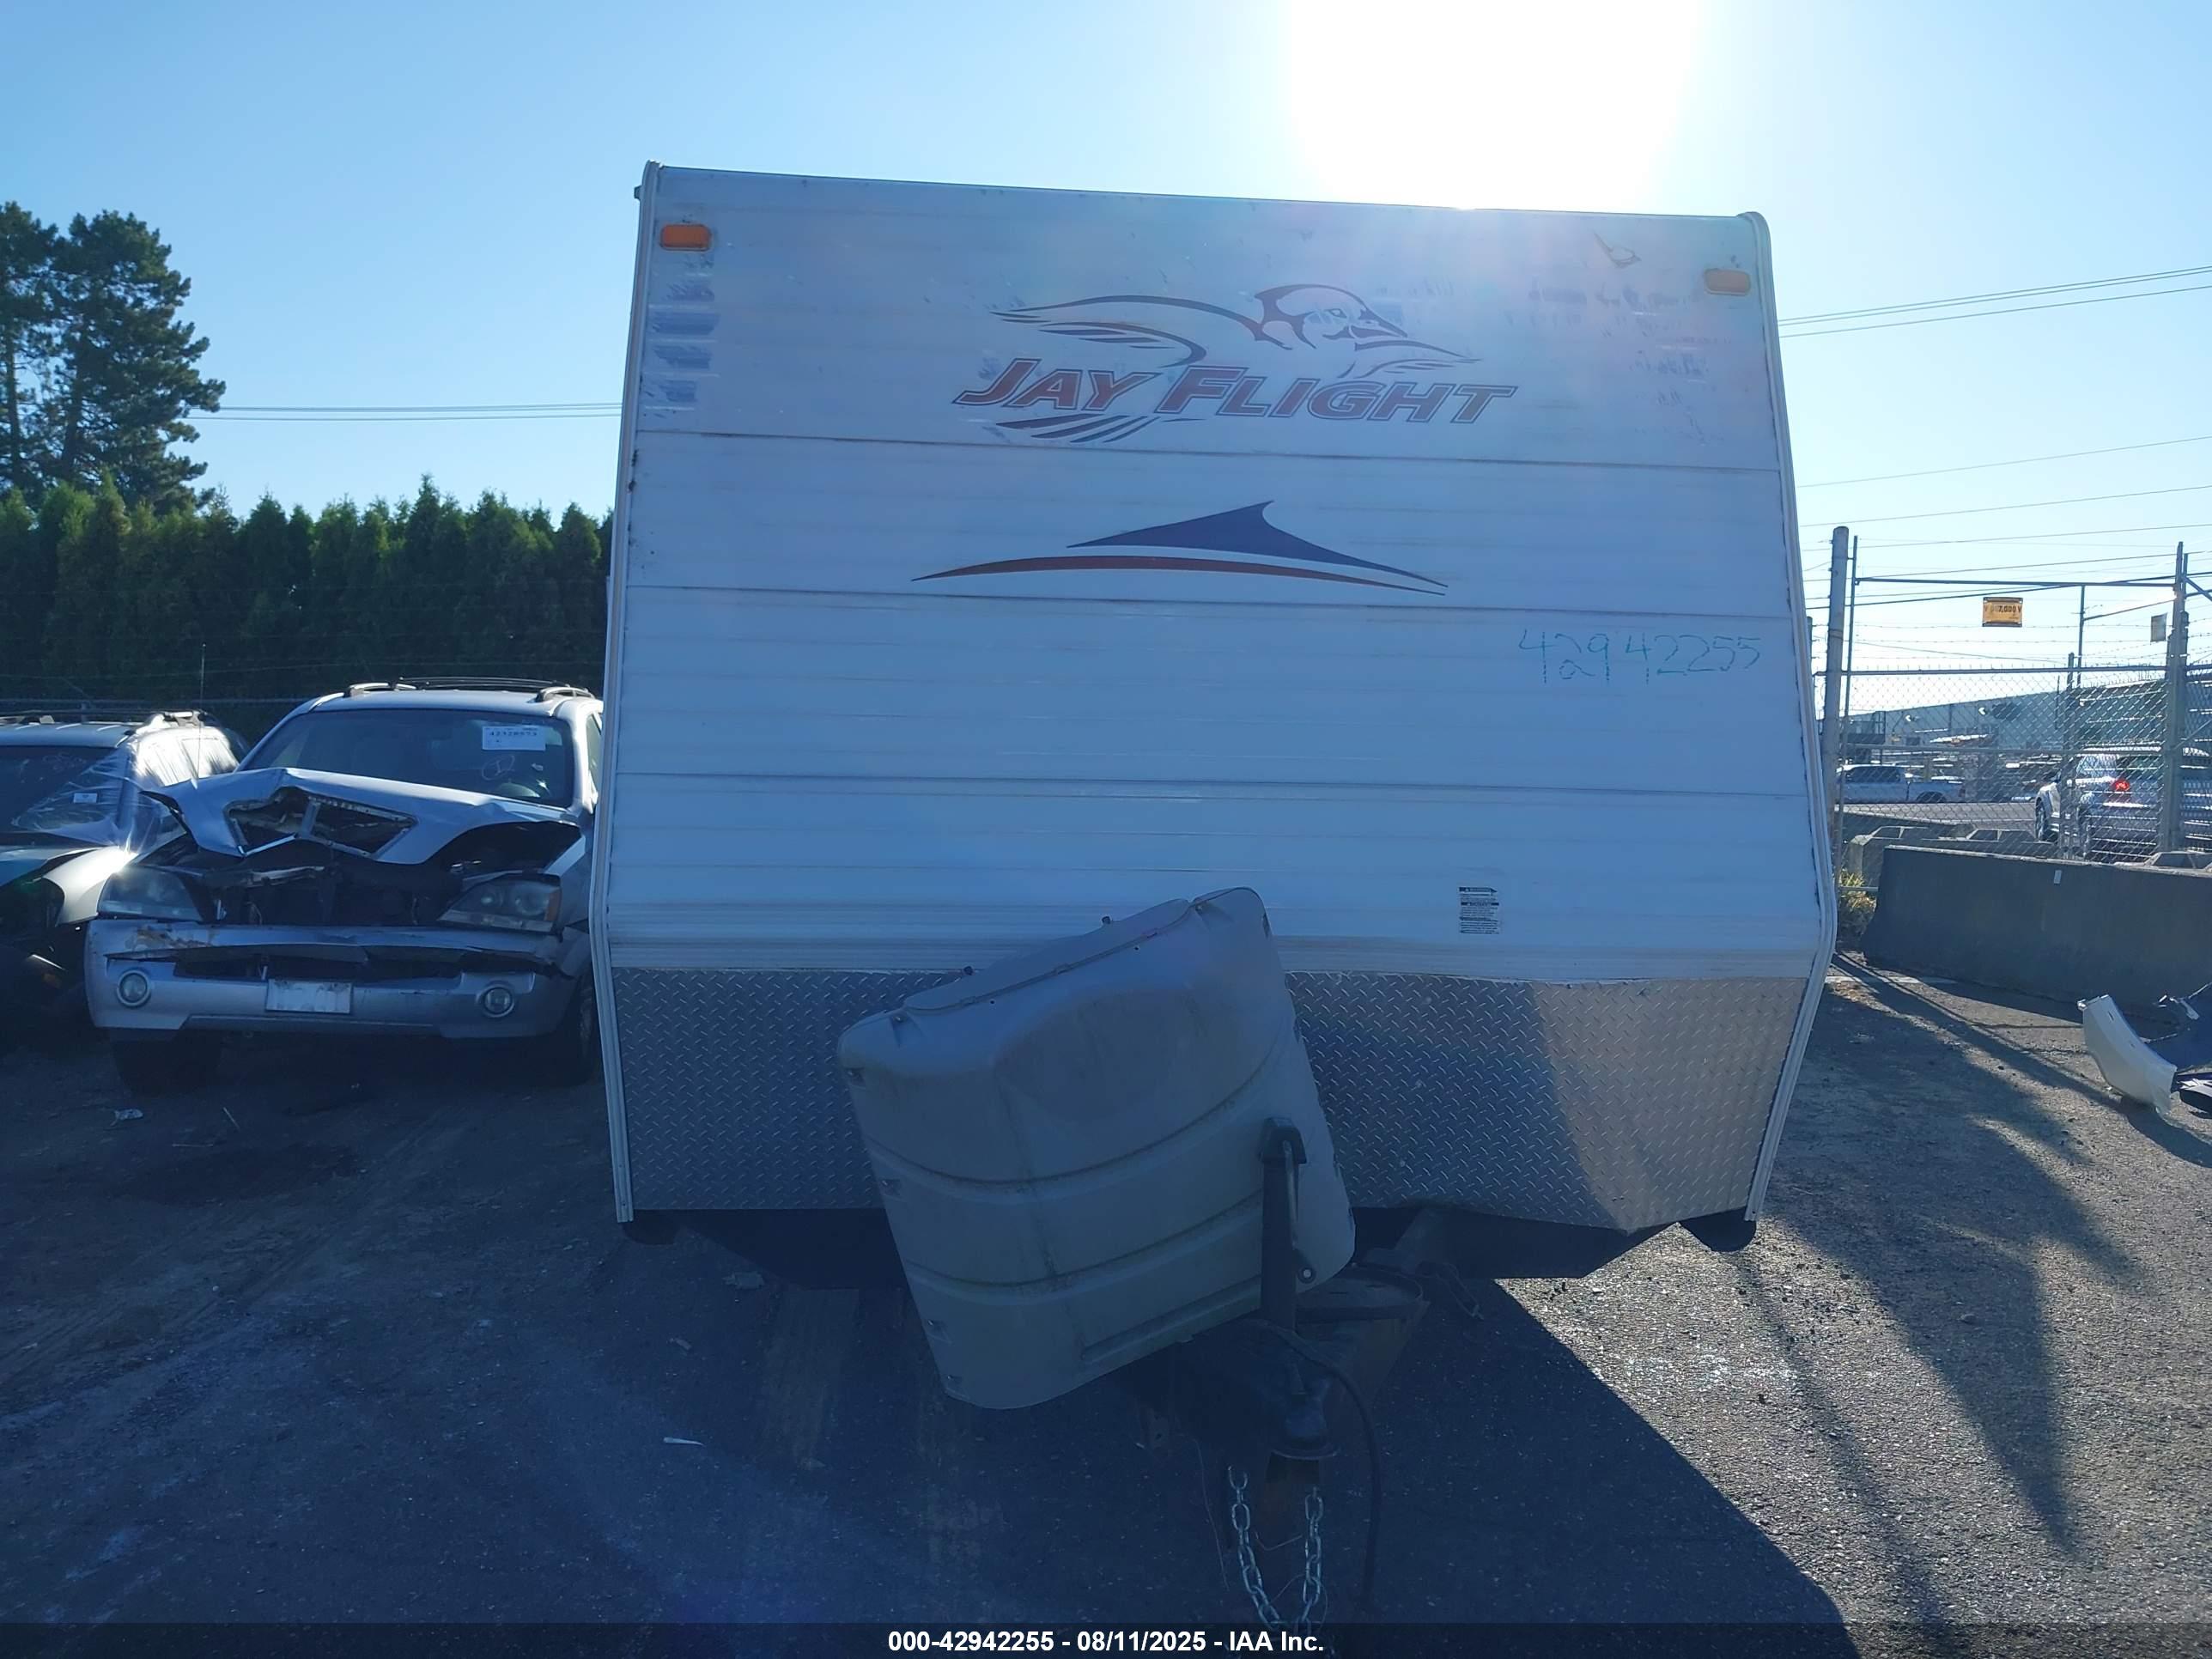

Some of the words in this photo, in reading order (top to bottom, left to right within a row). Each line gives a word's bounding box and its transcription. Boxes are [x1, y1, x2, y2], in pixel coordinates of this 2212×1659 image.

[951, 357, 1164, 413] JAY
[1154, 366, 1518, 423] FLIGHT
[1518, 629, 1762, 685] 42942255
